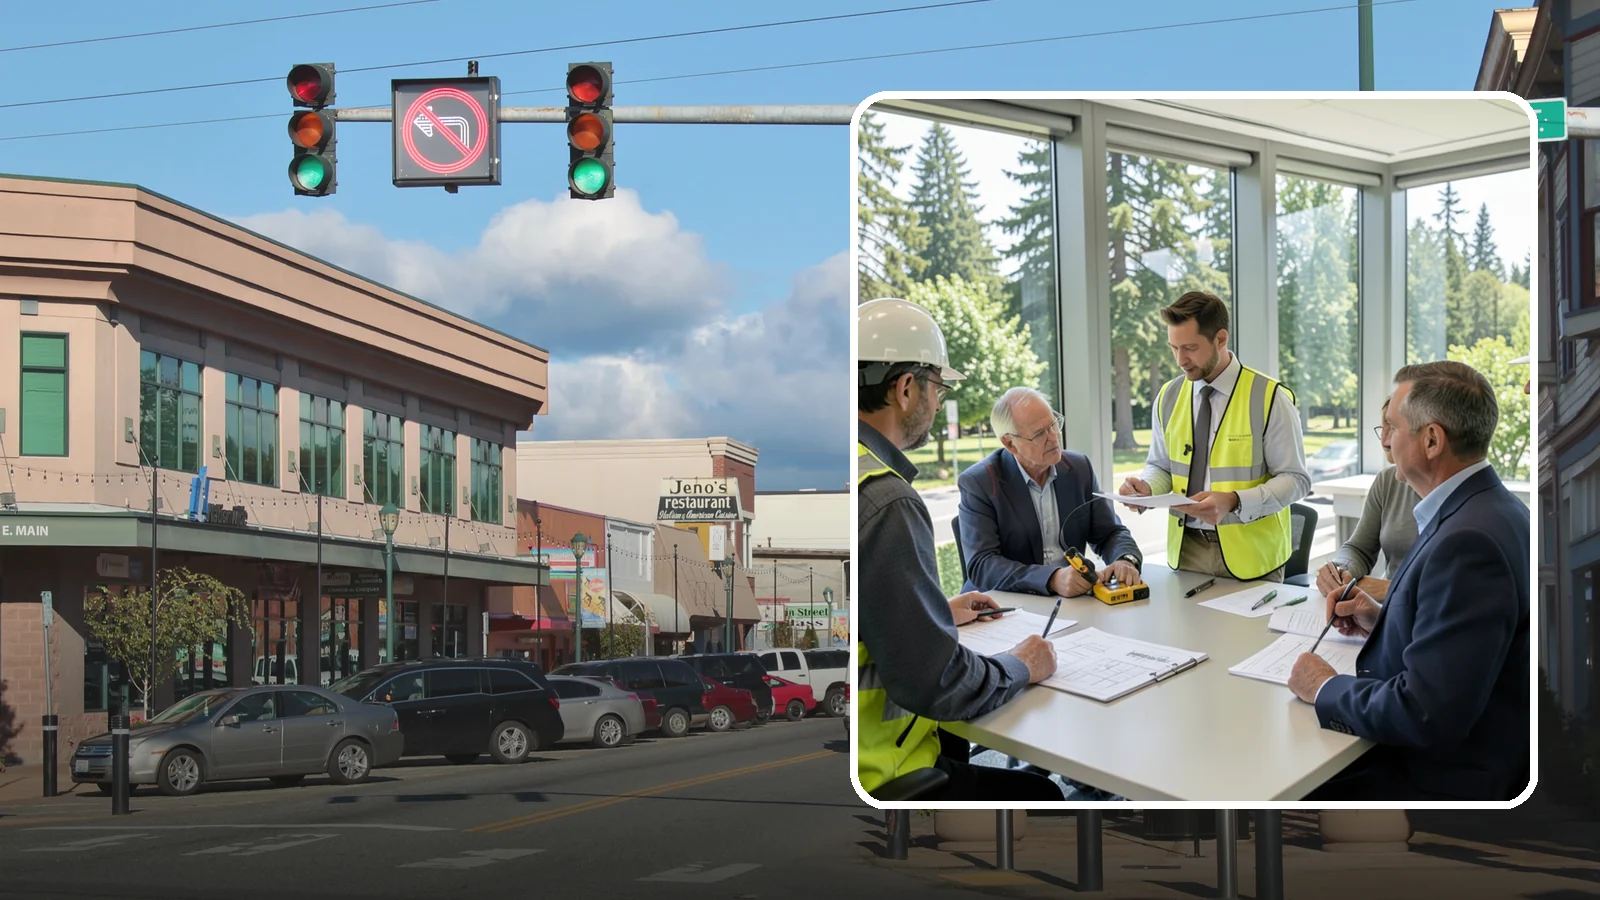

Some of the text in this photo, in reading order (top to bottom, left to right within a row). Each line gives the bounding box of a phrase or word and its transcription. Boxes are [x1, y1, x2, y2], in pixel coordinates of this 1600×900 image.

[670, 480, 727, 494] Jeno's
[665, 496, 731, 509] restaurant
[658, 510, 681, 519] Italian
[686, 509, 714, 519] American
[715, 509, 738, 519] Cuisine
[2, 525, 49, 536] E. MAIN
[786, 608, 795, 616] in
[798, 608, 828, 616] Street
[791, 619, 823, 627] lass
